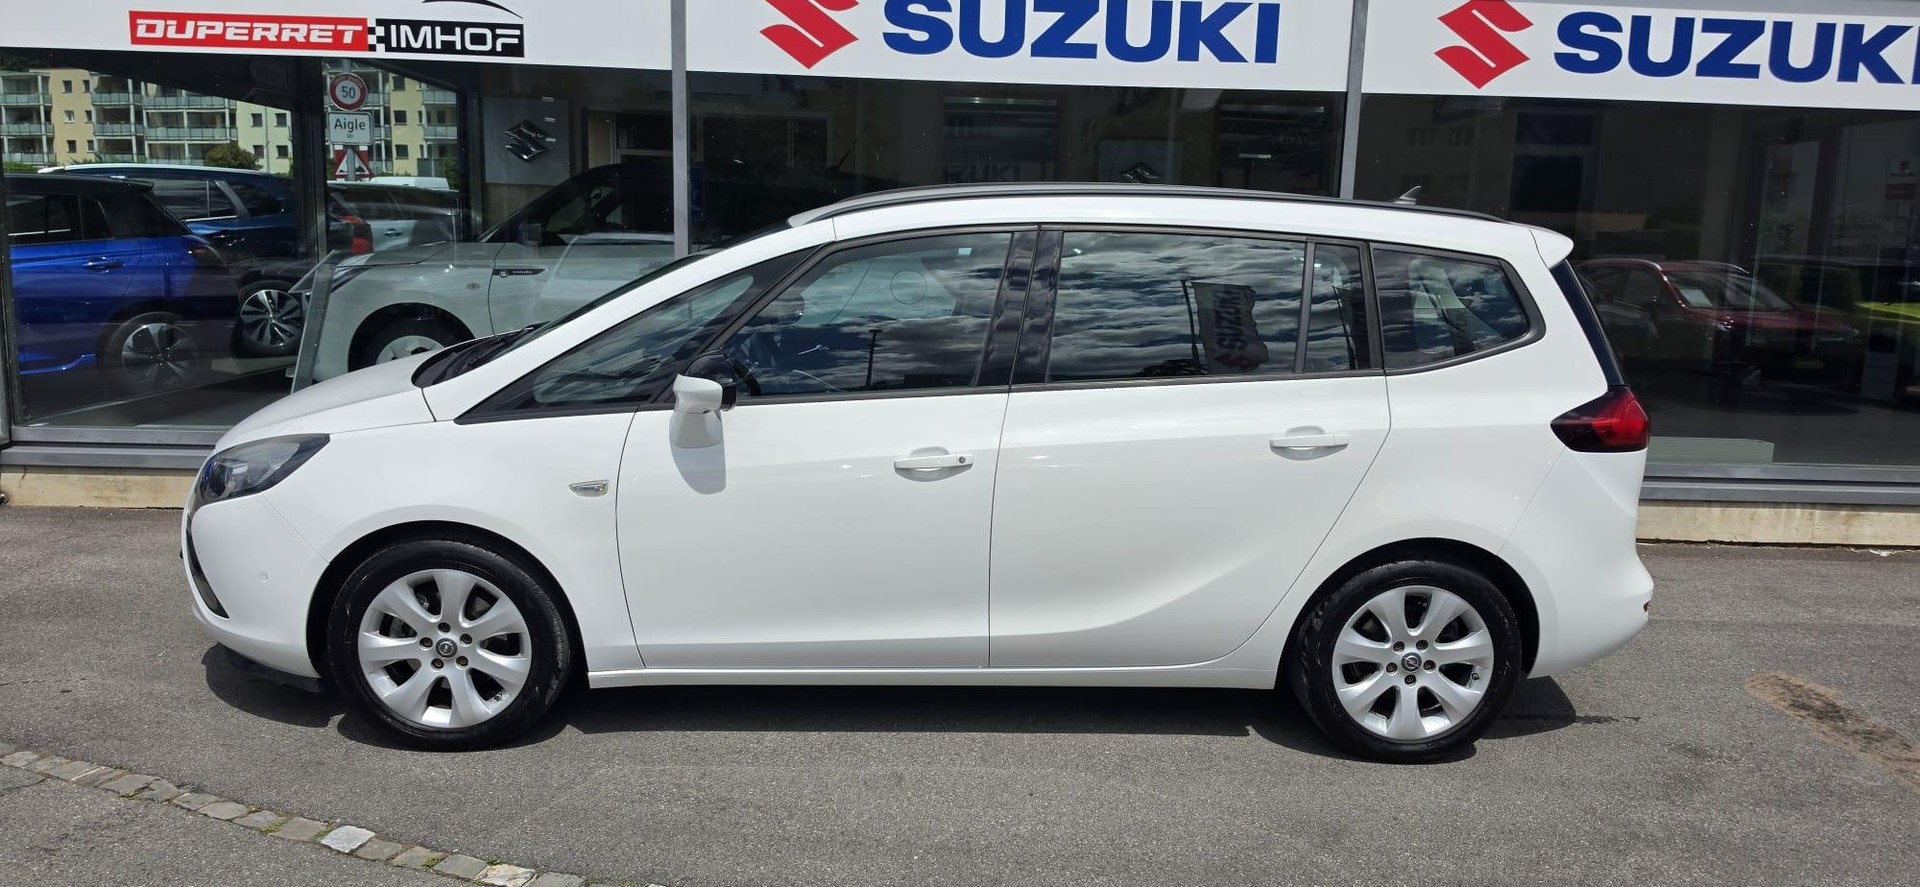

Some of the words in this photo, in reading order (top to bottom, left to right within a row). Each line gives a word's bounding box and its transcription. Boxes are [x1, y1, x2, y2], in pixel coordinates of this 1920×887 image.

[135, 18, 364, 44] DUPERRET
[389, 24, 520, 52] IMHOF
[882, 0, 1281, 64] SUZUKI
[341, 86, 356, 99] 50
[334, 118, 366, 133] Aigle
[1213, 290, 1248, 350] SUZUKI
